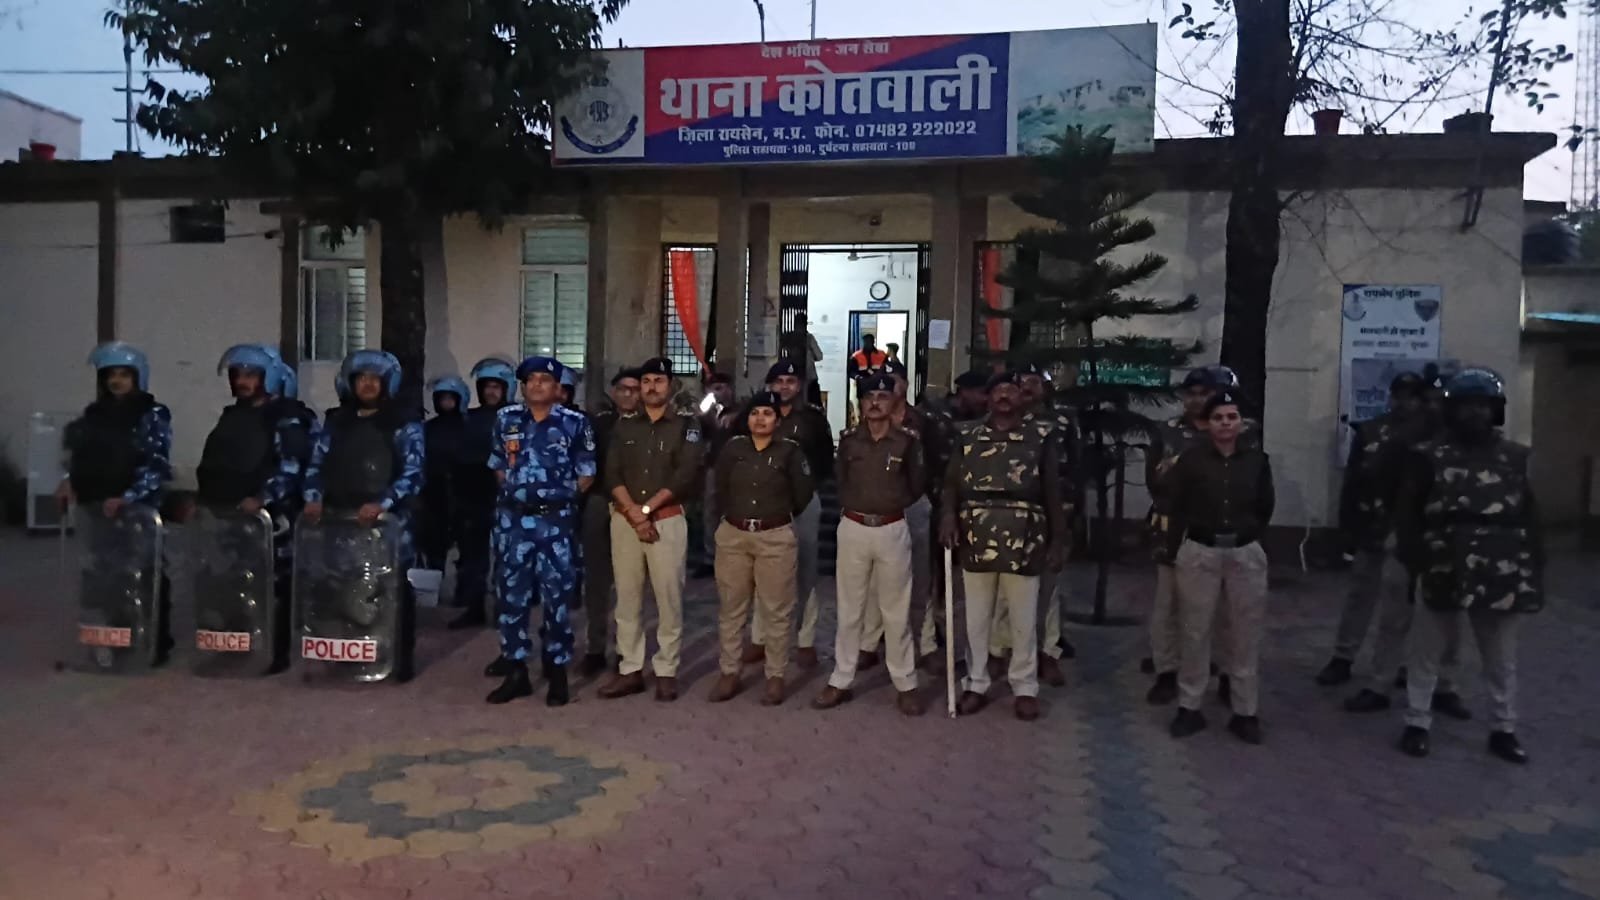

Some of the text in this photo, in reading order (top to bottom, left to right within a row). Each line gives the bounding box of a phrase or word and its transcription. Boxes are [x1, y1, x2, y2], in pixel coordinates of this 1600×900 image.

[786, 42, 821, 57] भक्ति
[835, 43, 860, 56] जन
[862, 40, 889, 54] सेवा
[660, 54, 998, 119] थाना कोतवाली
[718, 124, 768, 142] रायसेन,
[855, 123, 907, 138] 07482
[912, 120, 977, 136] 222022
[723, 143, 750, 158] पुलिस
[197, 632, 250, 649] POLICE
[303, 639, 375, 661] POLICE
